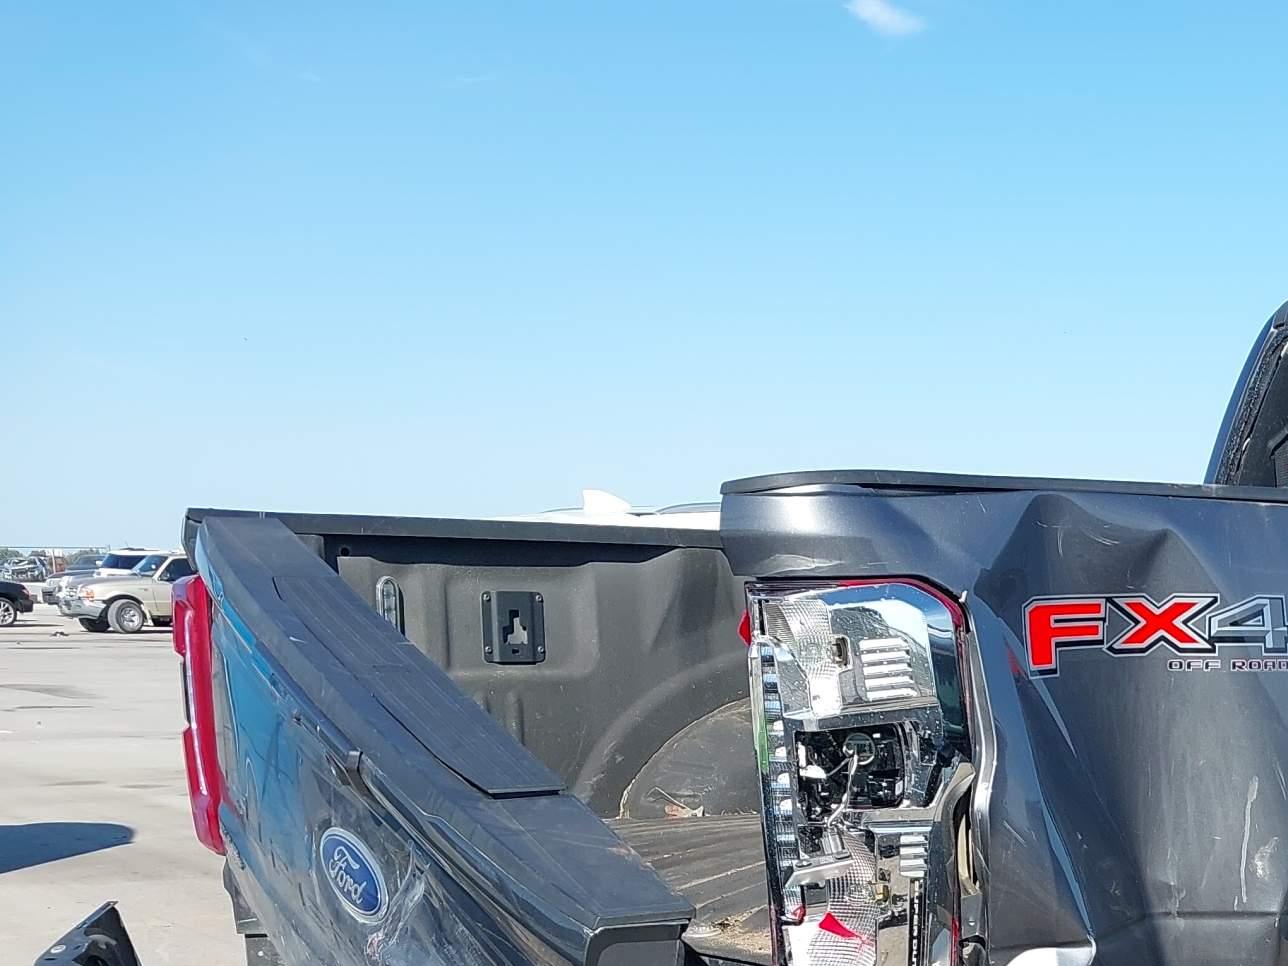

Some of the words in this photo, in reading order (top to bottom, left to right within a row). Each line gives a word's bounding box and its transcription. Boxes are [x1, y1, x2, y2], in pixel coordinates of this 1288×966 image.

[1167, 659, 1221, 672] OFF
[328, 845, 367, 905] Ford
[911, 880, 920, 937] SUPER
